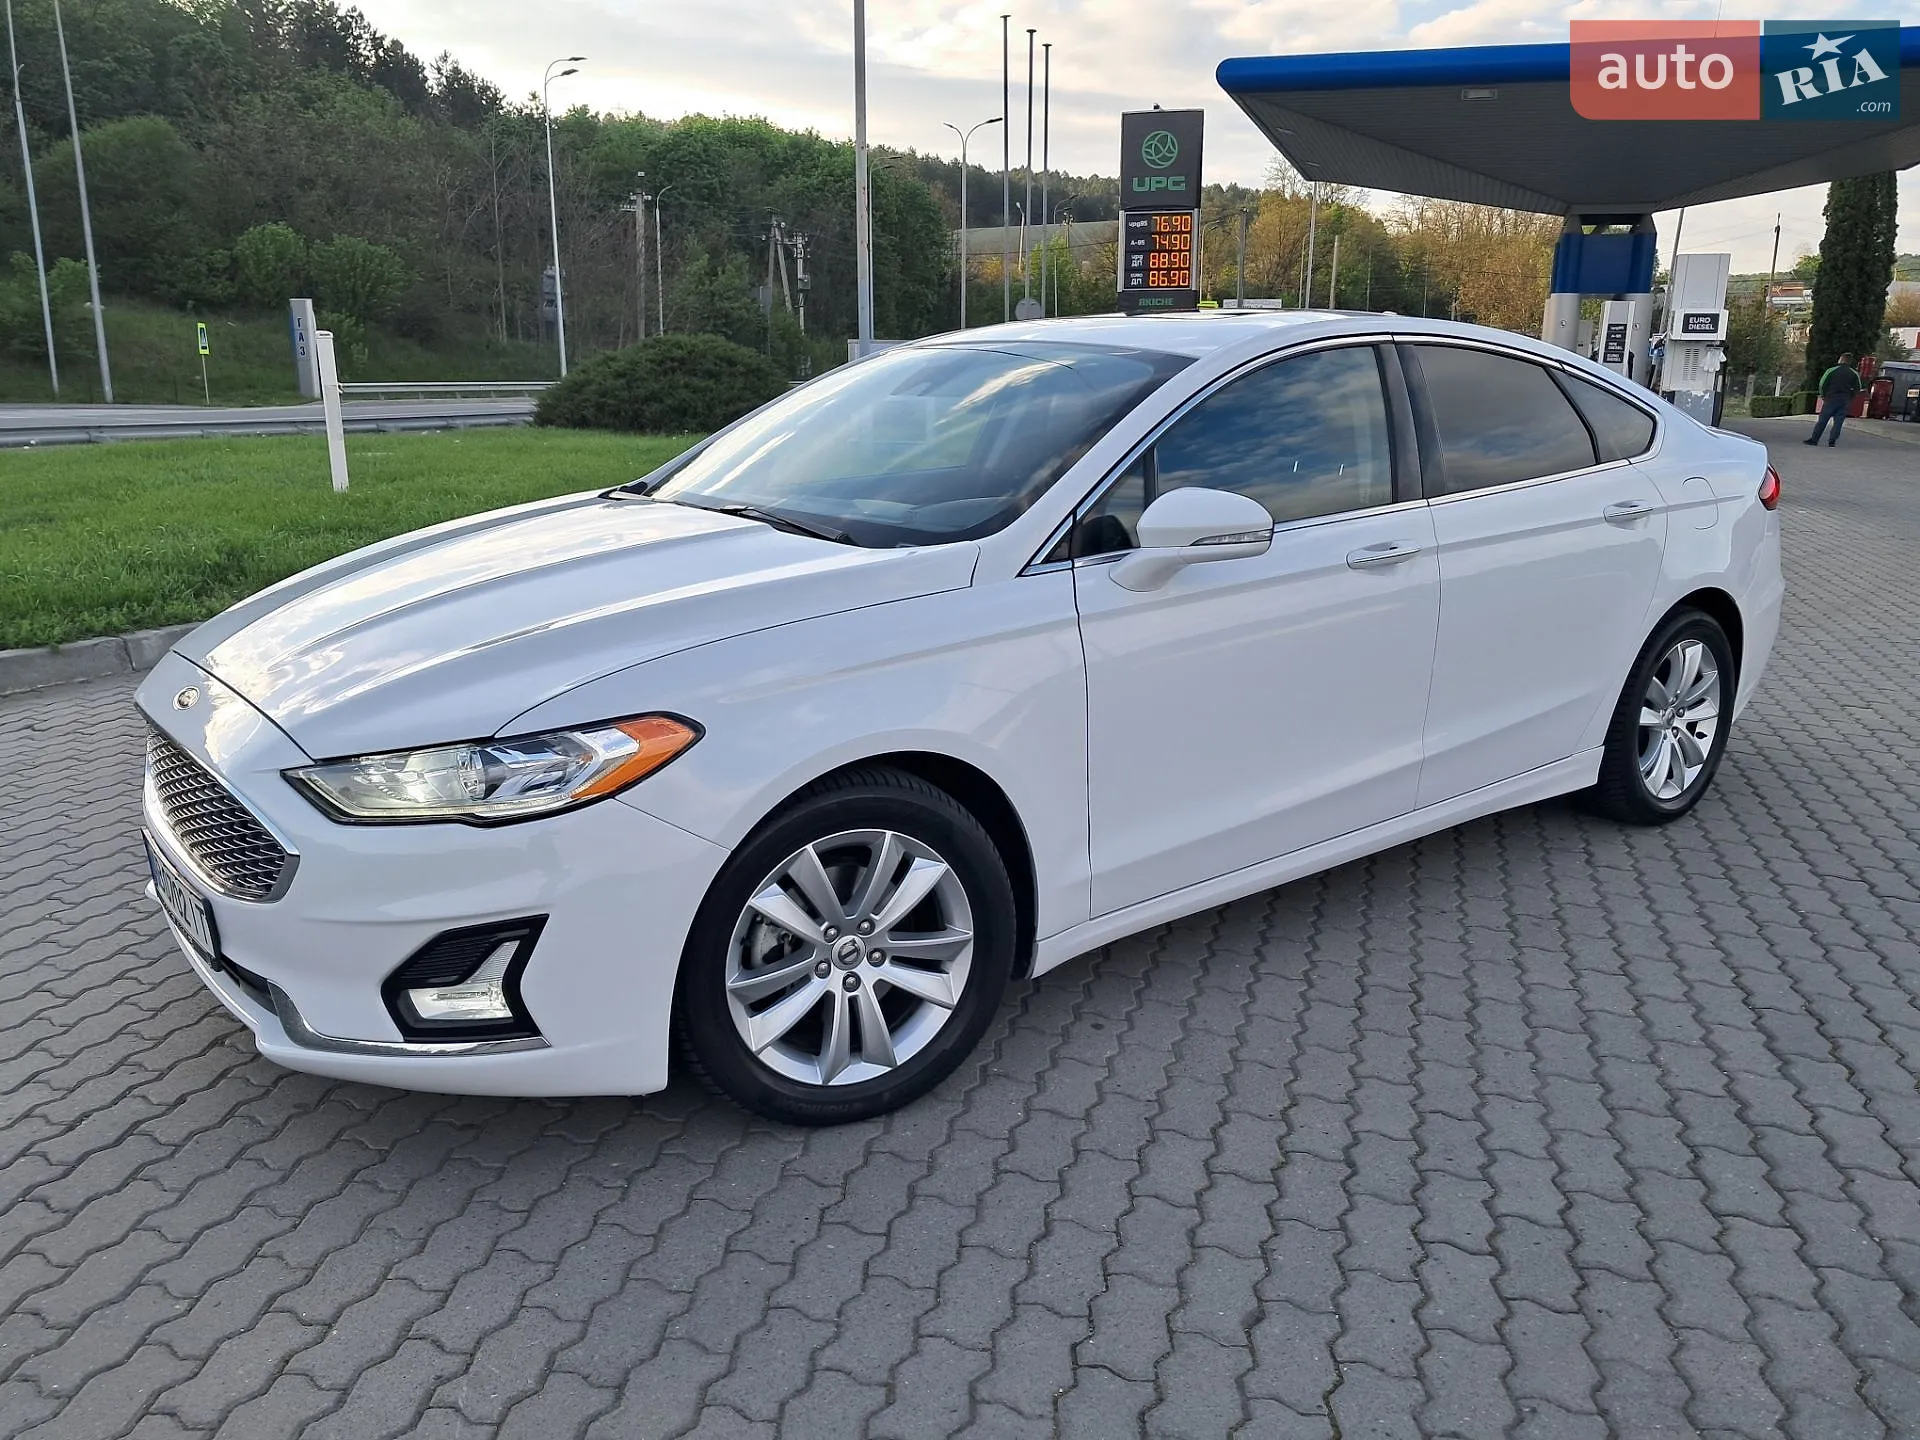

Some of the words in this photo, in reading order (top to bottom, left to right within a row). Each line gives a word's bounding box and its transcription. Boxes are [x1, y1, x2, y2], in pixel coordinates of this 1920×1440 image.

[1132, 176, 1186, 191] UPG
[1128, 220, 1148, 228] upg95
[1152, 215, 1191, 232] 76.90
[1151, 234, 1190, 250] 74.90
[1149, 252, 1189, 268] 88.90
[1149, 270, 1189, 286] 86.90
[1689, 316, 1711, 324] EURO
[297, 317, 306, 356] ГАЗ
